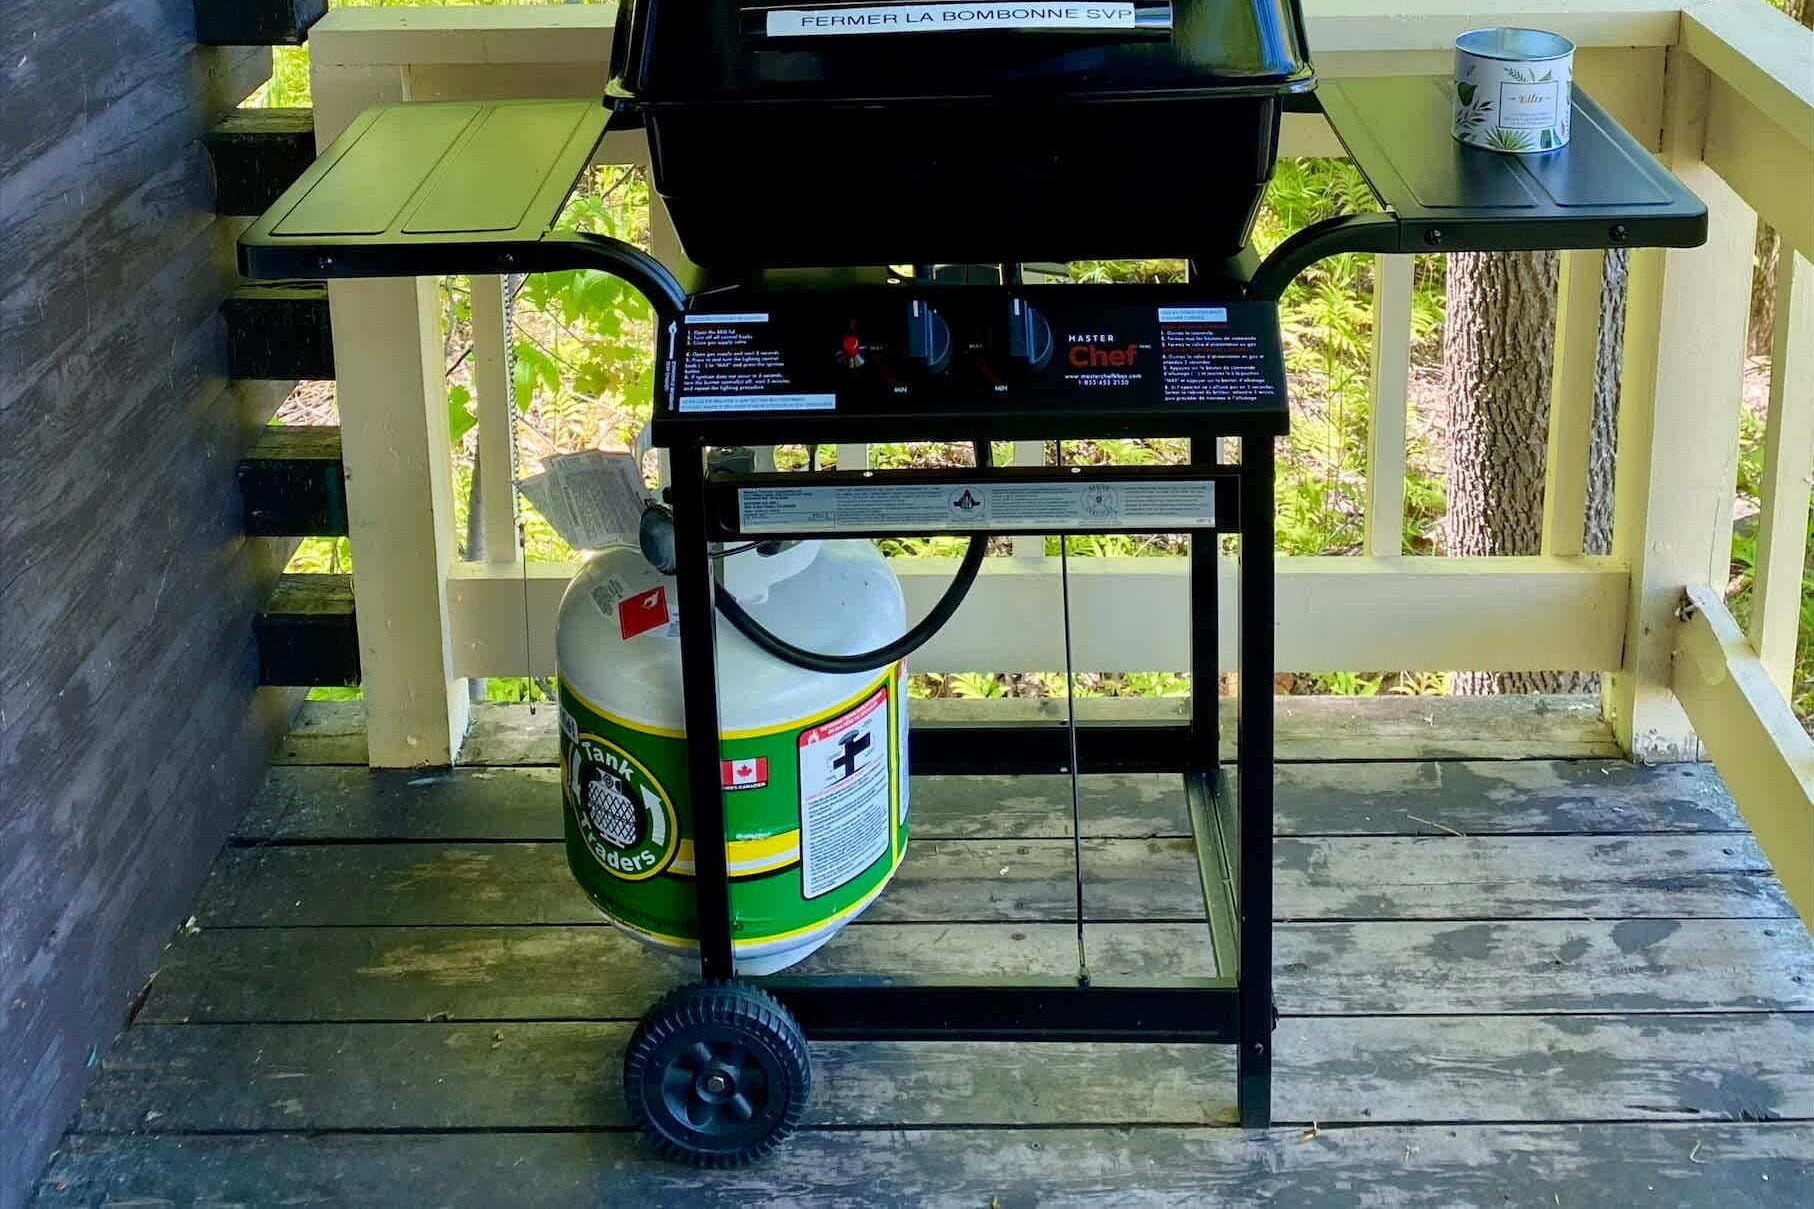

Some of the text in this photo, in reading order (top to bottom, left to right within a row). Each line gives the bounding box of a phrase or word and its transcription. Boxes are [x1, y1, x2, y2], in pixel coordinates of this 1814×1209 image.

[801, 7, 1133, 28] FERMER LA BOMBONNE SVP
[1068, 334, 1115, 343] MASTER
[1068, 344, 1139, 368] Chef
[580, 741, 634, 783] Tank
[580, 811, 656, 872] Traders
